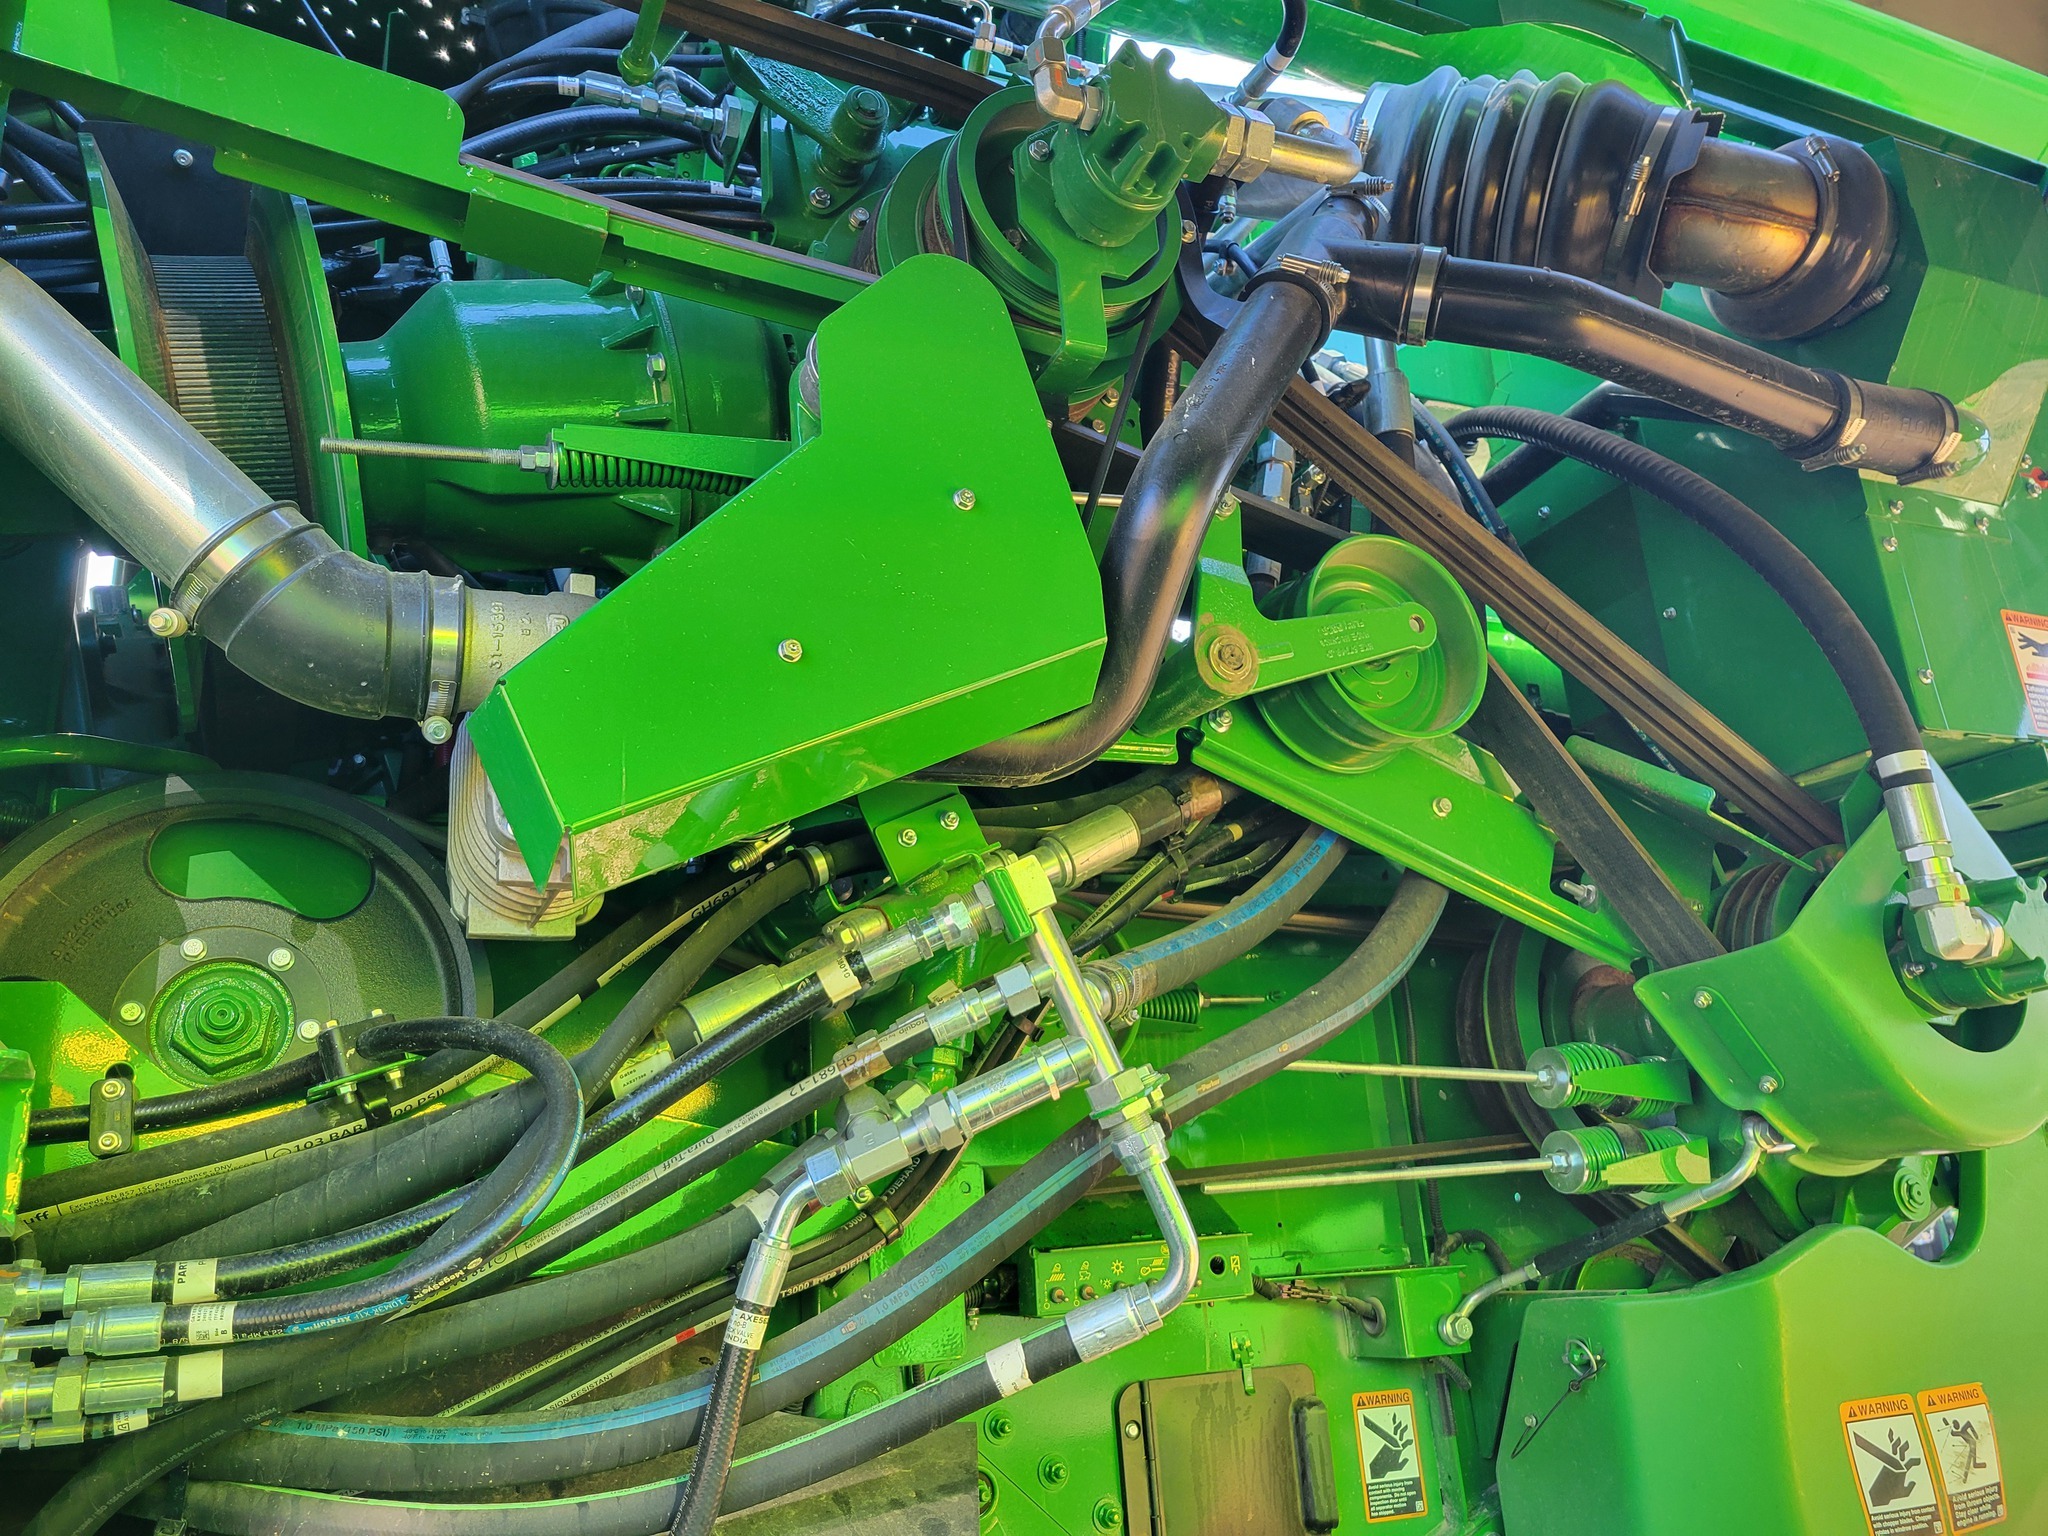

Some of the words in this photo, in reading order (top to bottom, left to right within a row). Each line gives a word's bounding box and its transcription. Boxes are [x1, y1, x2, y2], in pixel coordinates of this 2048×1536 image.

[1088, 908, 1104, 923] FRAS
[1108, 879, 1136, 904] ABRASION
[620, 1069, 637, 1079] Gates
[787, 1052, 857, 1098] GH681-12
[294, 1137, 324, 1152] 103
[329, 1123, 364, 1141] BAR
[418, 1088, 445, 1107] PSI)
[662, 1133, 715, 1173] Dura-Tuff
[23, 1211, 50, 1225] uff
[69, 1197, 100, 1211] Exceeds
[155, 1170, 208, 1189] Performance
[213, 1163, 232, 1172] DNV
[843, 1210, 867, 1231] T3000
[889, 1156, 921, 1196] DIEHARD
[780, 1282, 810, 1298] T3000
[840, 1243, 882, 1274] DIEHARD
[890, 1290, 910, 1307] MPa
[911, 1275, 929, 1294] (150
[930, 1261, 949, 1280] PSI)
[580, 1333, 602, 1347] FRAS
[610, 1309, 652, 1330] ABRASION
[651, 1289, 695, 1312] RESISTANT
[570, 1372, 614, 1399] RESISTANT
[1365, 1392, 1410, 1405] WARNING
[1937, 1388, 1980, 1405] WARNING
[1858, 1399, 1909, 1416] WARNING
[315, 1424, 338, 1433] MPa
[341, 1425, 365, 1436] (150
[367, 1427, 391, 1437] PSI)
[124, 1465, 160, 1491] Engineered
[167, 1452, 183, 1463] USA
[183, 1441, 203, 1453] Made
[209, 1429, 227, 1439] USA
[1952, 1493, 1967, 1502] Avoid
[1967, 1490, 1985, 1499] serious
[1984, 1486, 1998, 1495] injury
[1953, 1502, 1966, 1510] from
[1966, 1498, 1982, 1508] thrown
[1982, 1493, 2000, 1503] objects.
[1883, 1512, 1899, 1520] serious
[1899, 1510, 1911, 1518] injury
[1955, 1511, 1967, 1519] Stay
[1967, 1507, 1979, 1515] clear
[1979, 1503, 1992, 1512] while
[1957, 1518, 1973, 1527] engine
[1978, 1510, 1997, 1520] running.
[1882, 1520, 1899, 1529] chopper
[1900, 1517, 1914, 1525] blades.
[1915, 1514, 1932, 1523] Chopper
[1911, 1523, 1929, 1531] position.
